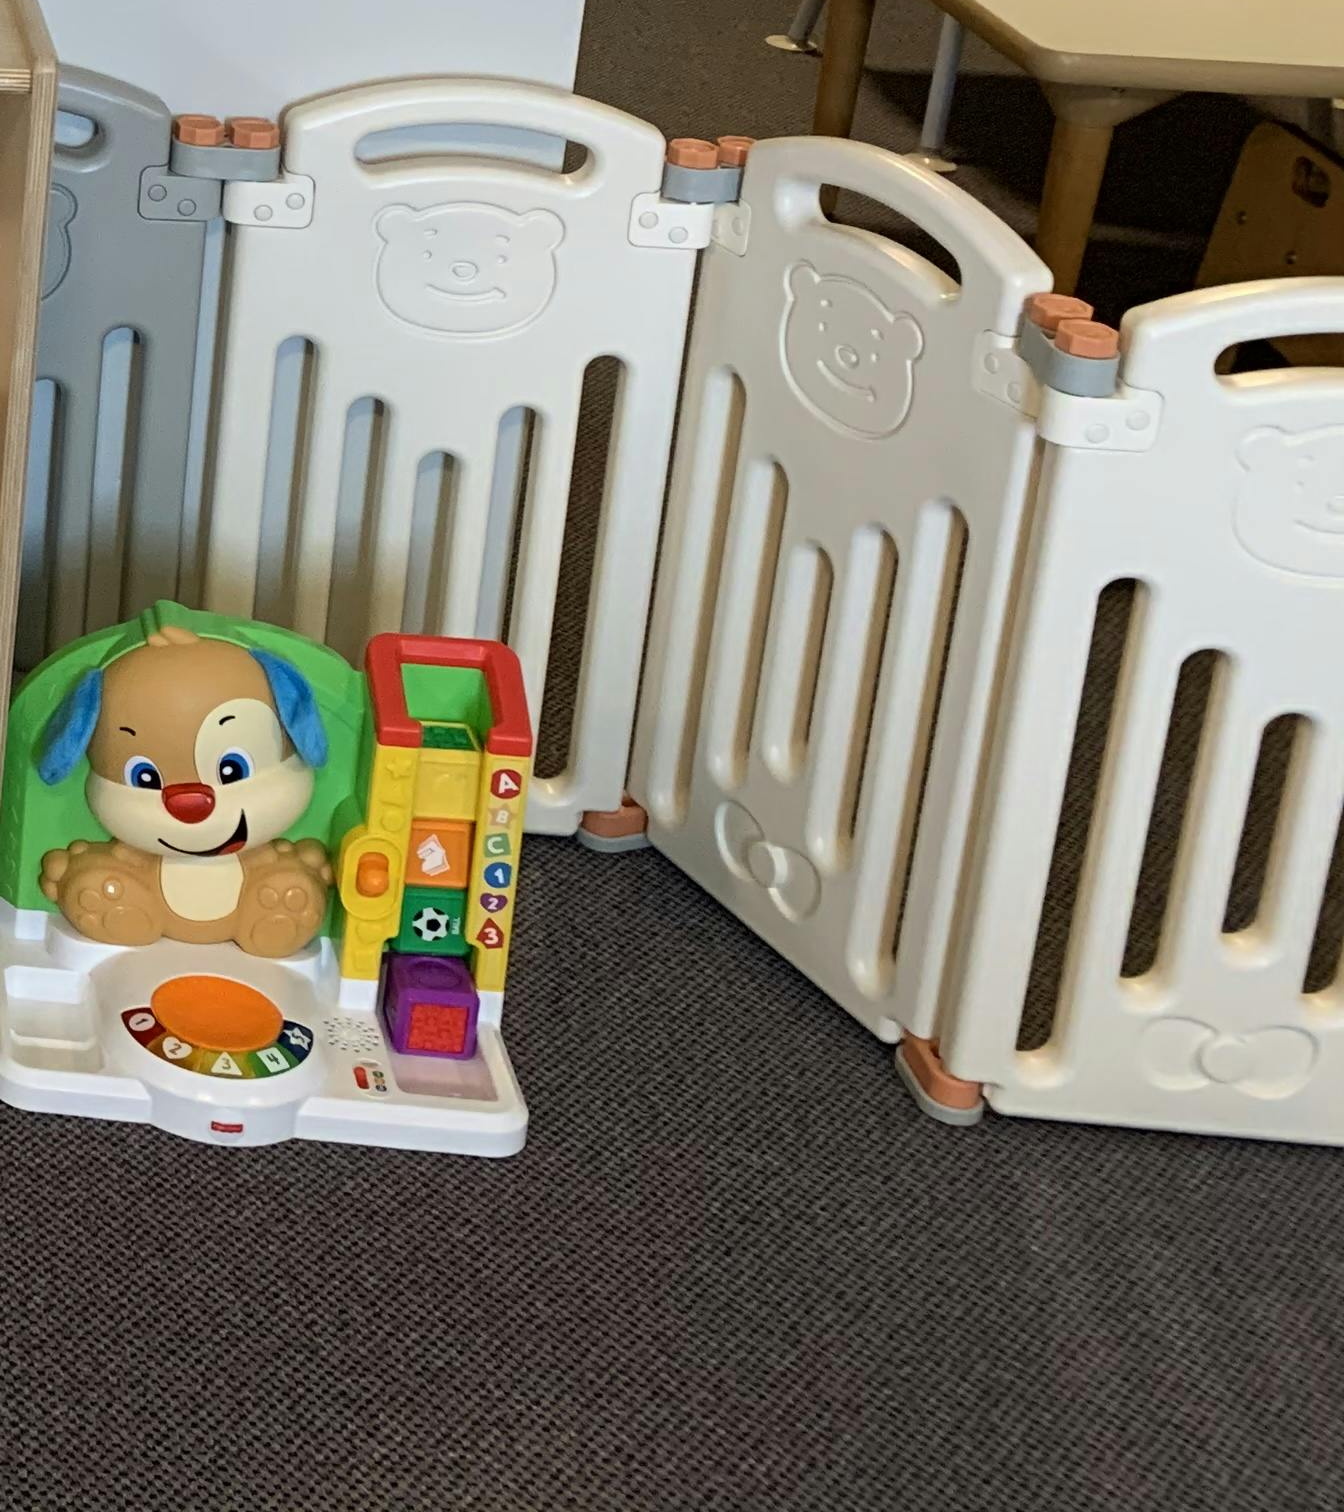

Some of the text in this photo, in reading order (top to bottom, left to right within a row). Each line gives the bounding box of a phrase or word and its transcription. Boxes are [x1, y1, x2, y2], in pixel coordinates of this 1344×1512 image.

[498, 773, 520, 794] A
[496, 810, 510, 824] B
[487, 836, 505, 854] C
[494, 868, 505, 884] 1
[487, 897, 499, 910] 2
[484, 927, 500, 945] 3
[169, 1042, 183, 1055] 2
[221, 1057, 232, 1071] 3
[265, 1053, 282, 1066] 4
